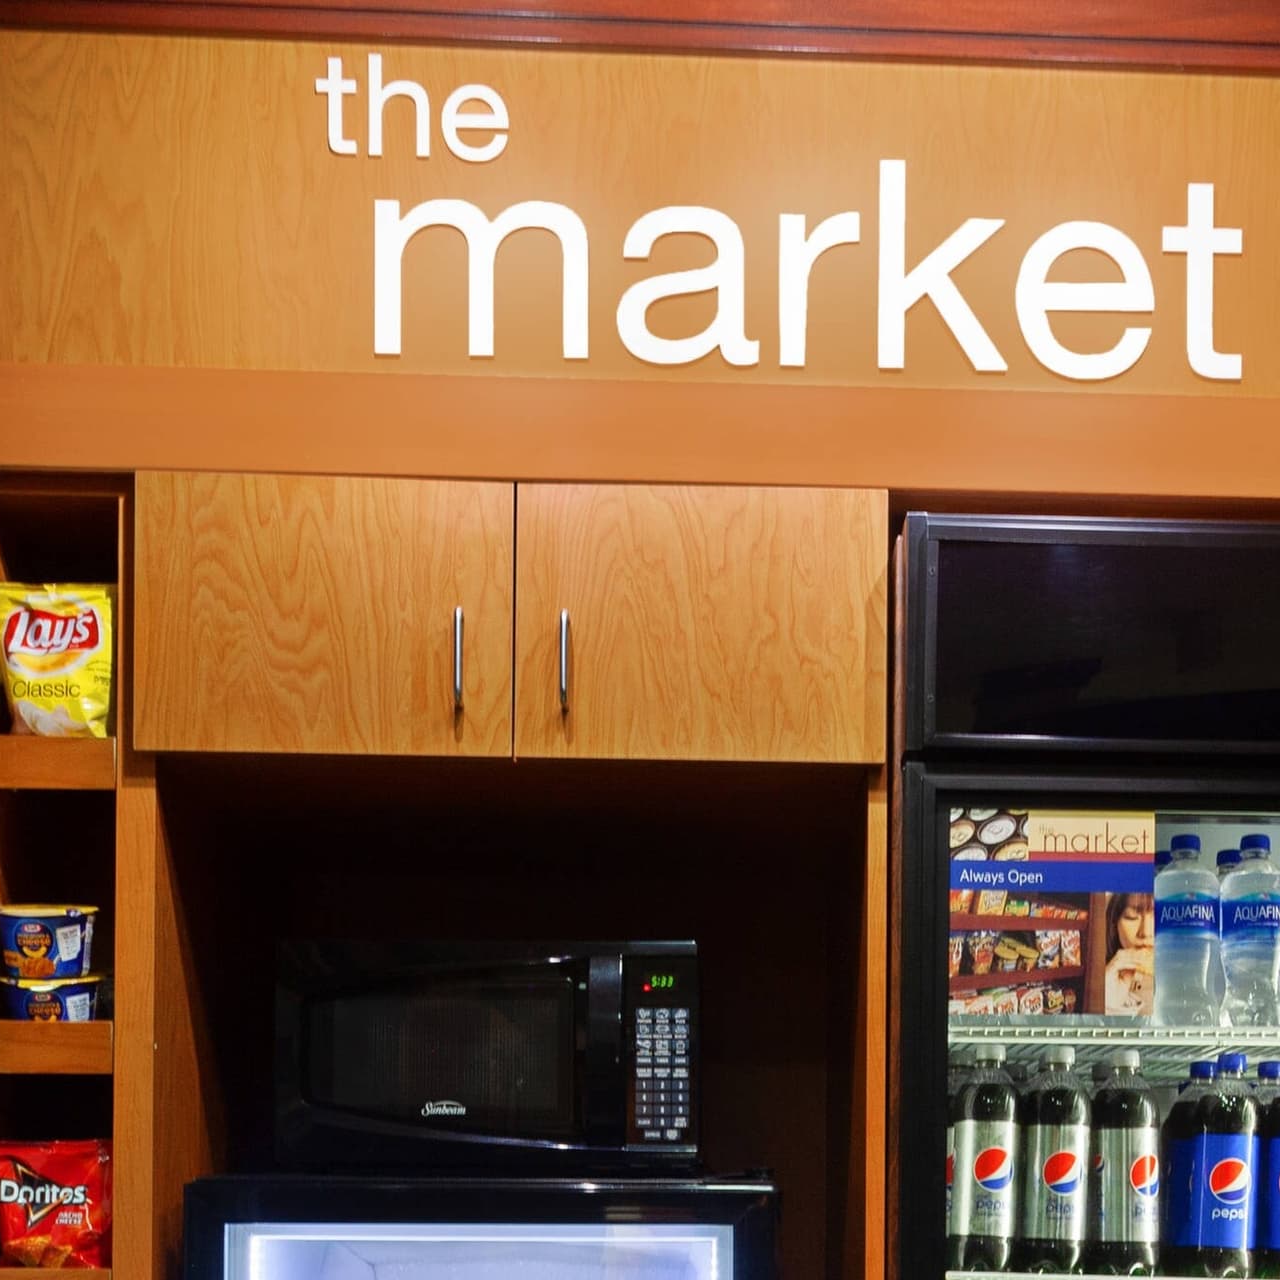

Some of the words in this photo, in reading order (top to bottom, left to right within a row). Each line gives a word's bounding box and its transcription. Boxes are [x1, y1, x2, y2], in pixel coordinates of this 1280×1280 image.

[315, 53, 510, 163] the
[373, 159, 1243, 382] market
[12, 679, 81, 698] Classic
[1043, 821, 1150, 854] market
[959, 869, 1005, 886] Always
[1007, 869, 1043, 886] Open
[1160, 904, 1216, 924] AQUAFINA
[421, 1101, 466, 1117] Sunbeam
[0, 1179, 88, 1206] Doritos
